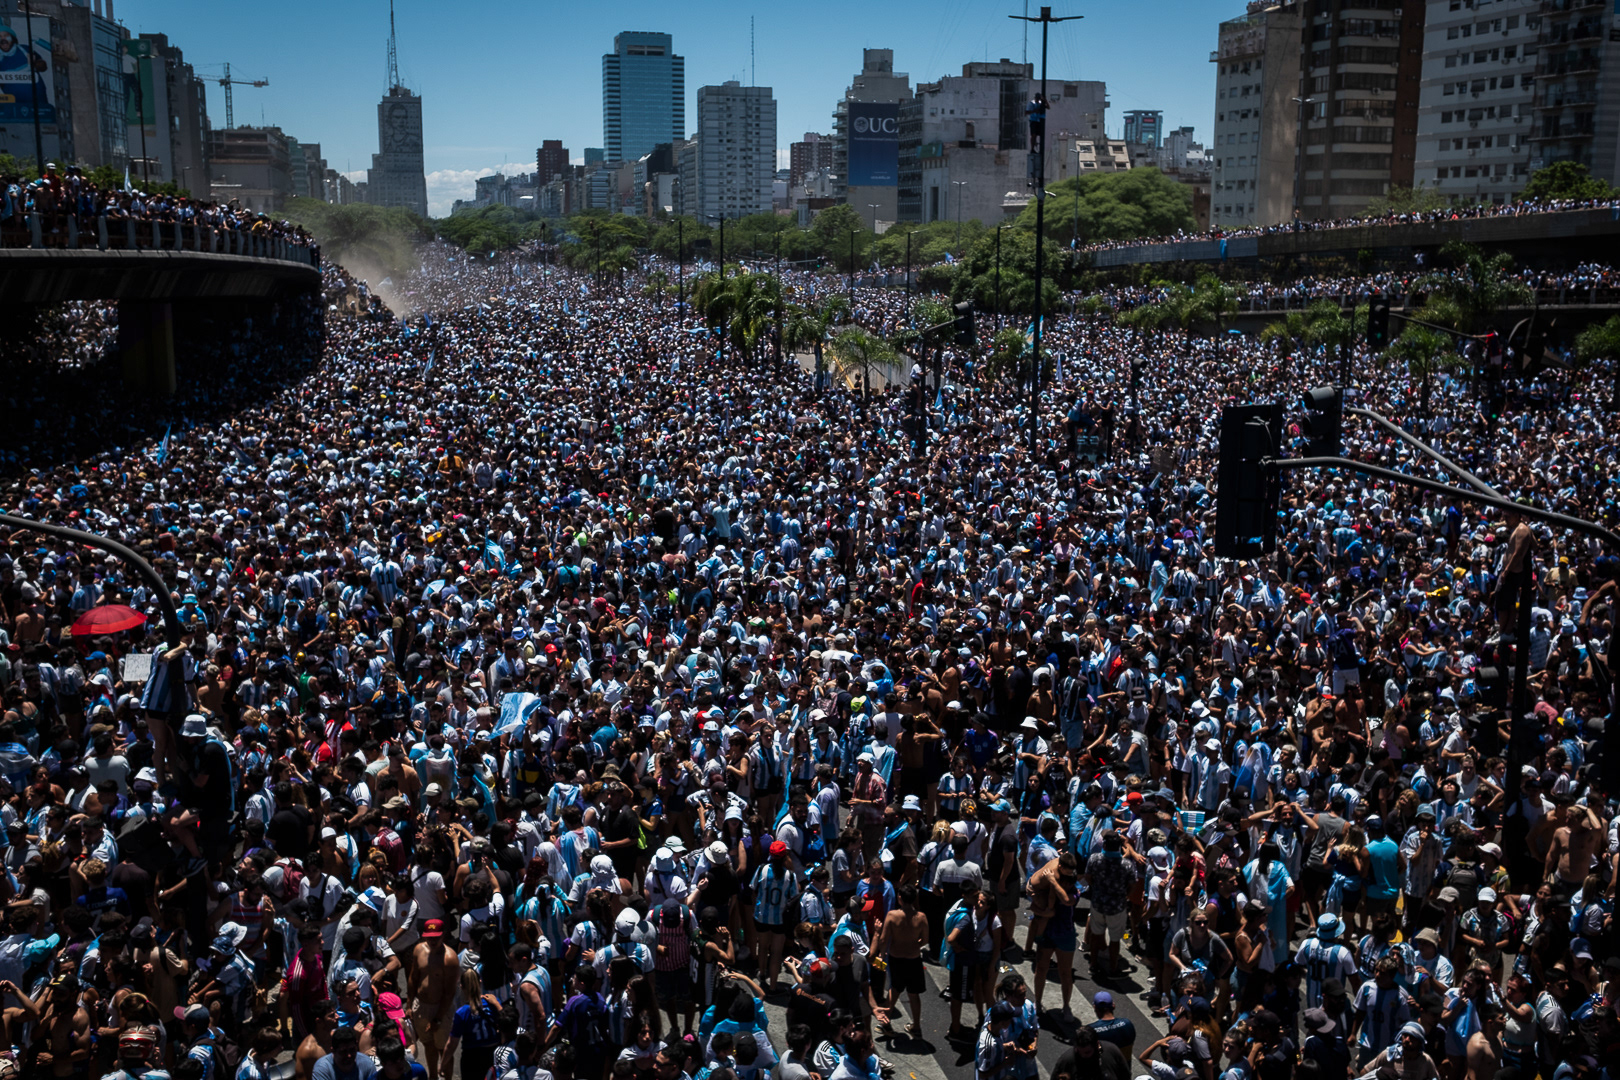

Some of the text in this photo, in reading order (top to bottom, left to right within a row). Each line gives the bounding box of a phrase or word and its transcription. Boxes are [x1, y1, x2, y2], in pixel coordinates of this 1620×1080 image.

[869, 117, 899, 133] UC
[378, 571, 392, 585] 11
[765, 887, 782, 905] 10
[1309, 958, 1328, 981] 10
